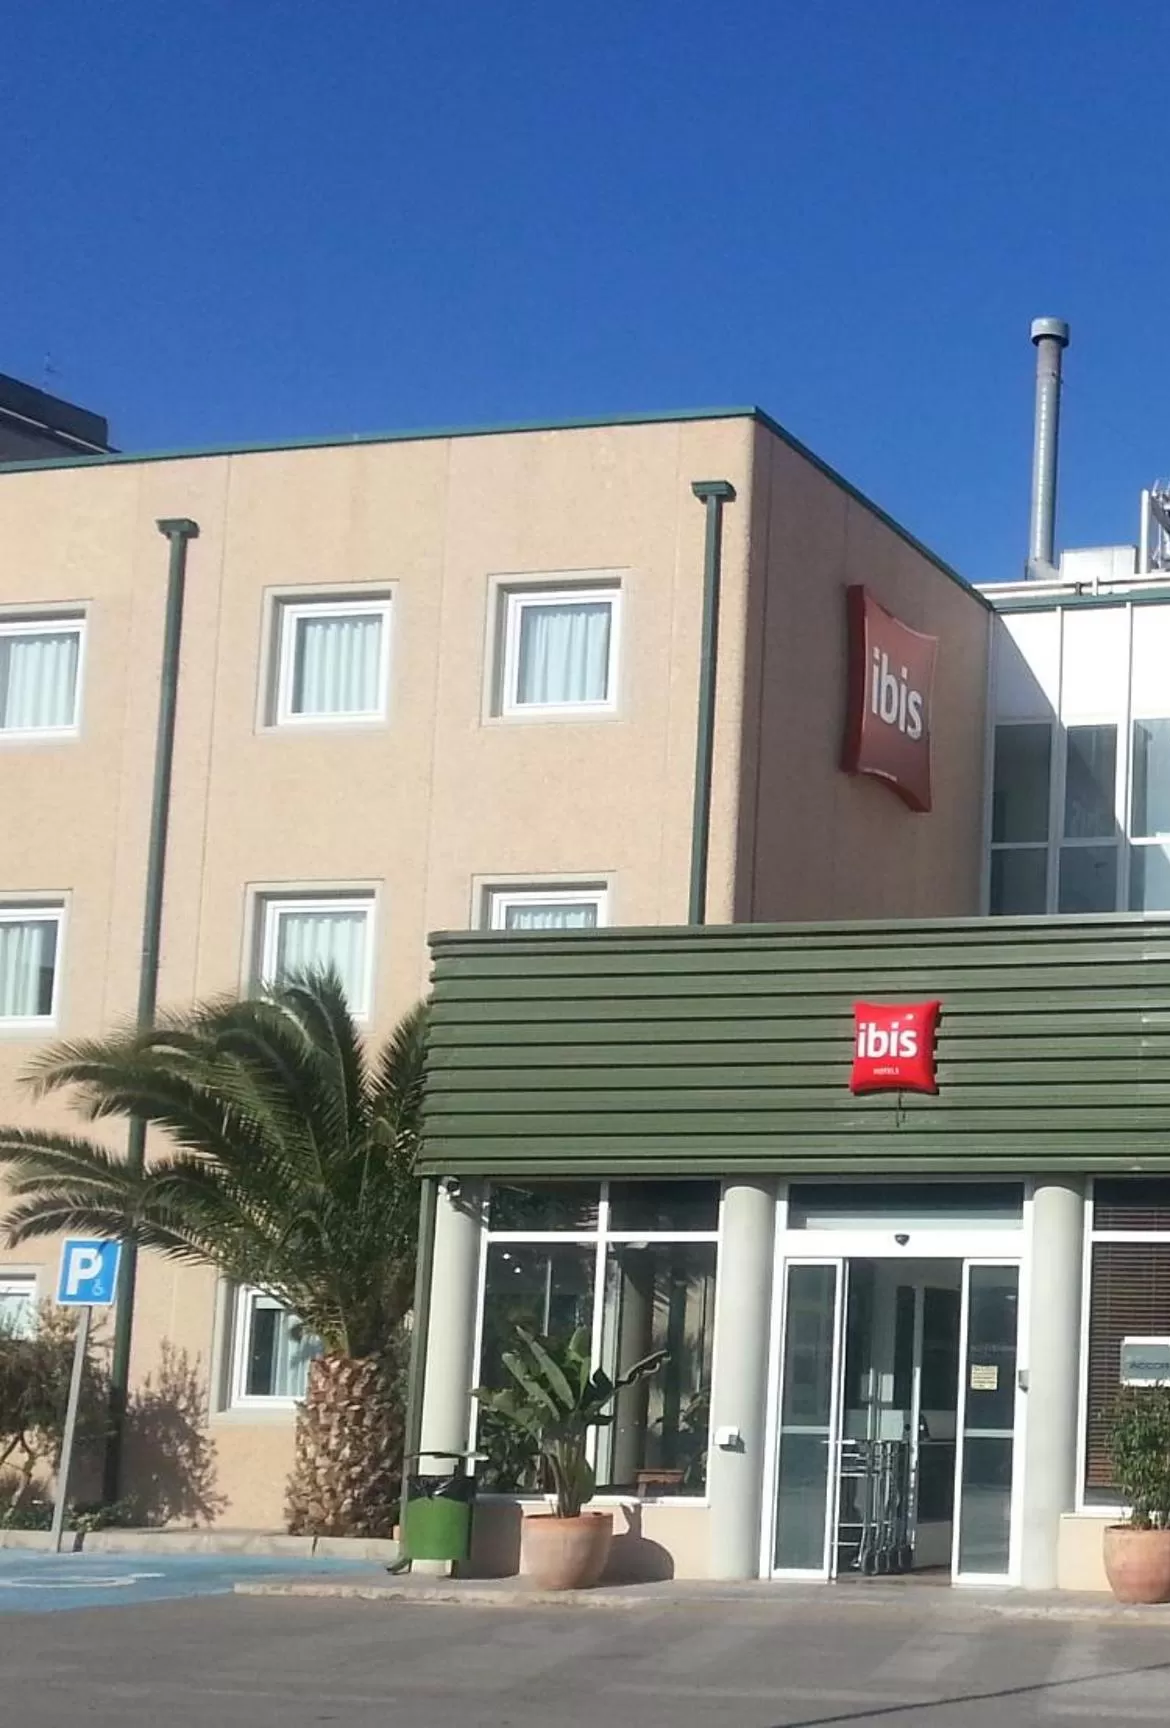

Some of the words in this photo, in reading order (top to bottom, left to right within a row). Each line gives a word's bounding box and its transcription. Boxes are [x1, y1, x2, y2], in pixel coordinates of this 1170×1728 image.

[871, 646, 923, 740] ibis
[857, 1021, 917, 1058] ibis
[66, 1248, 103, 1295] P
